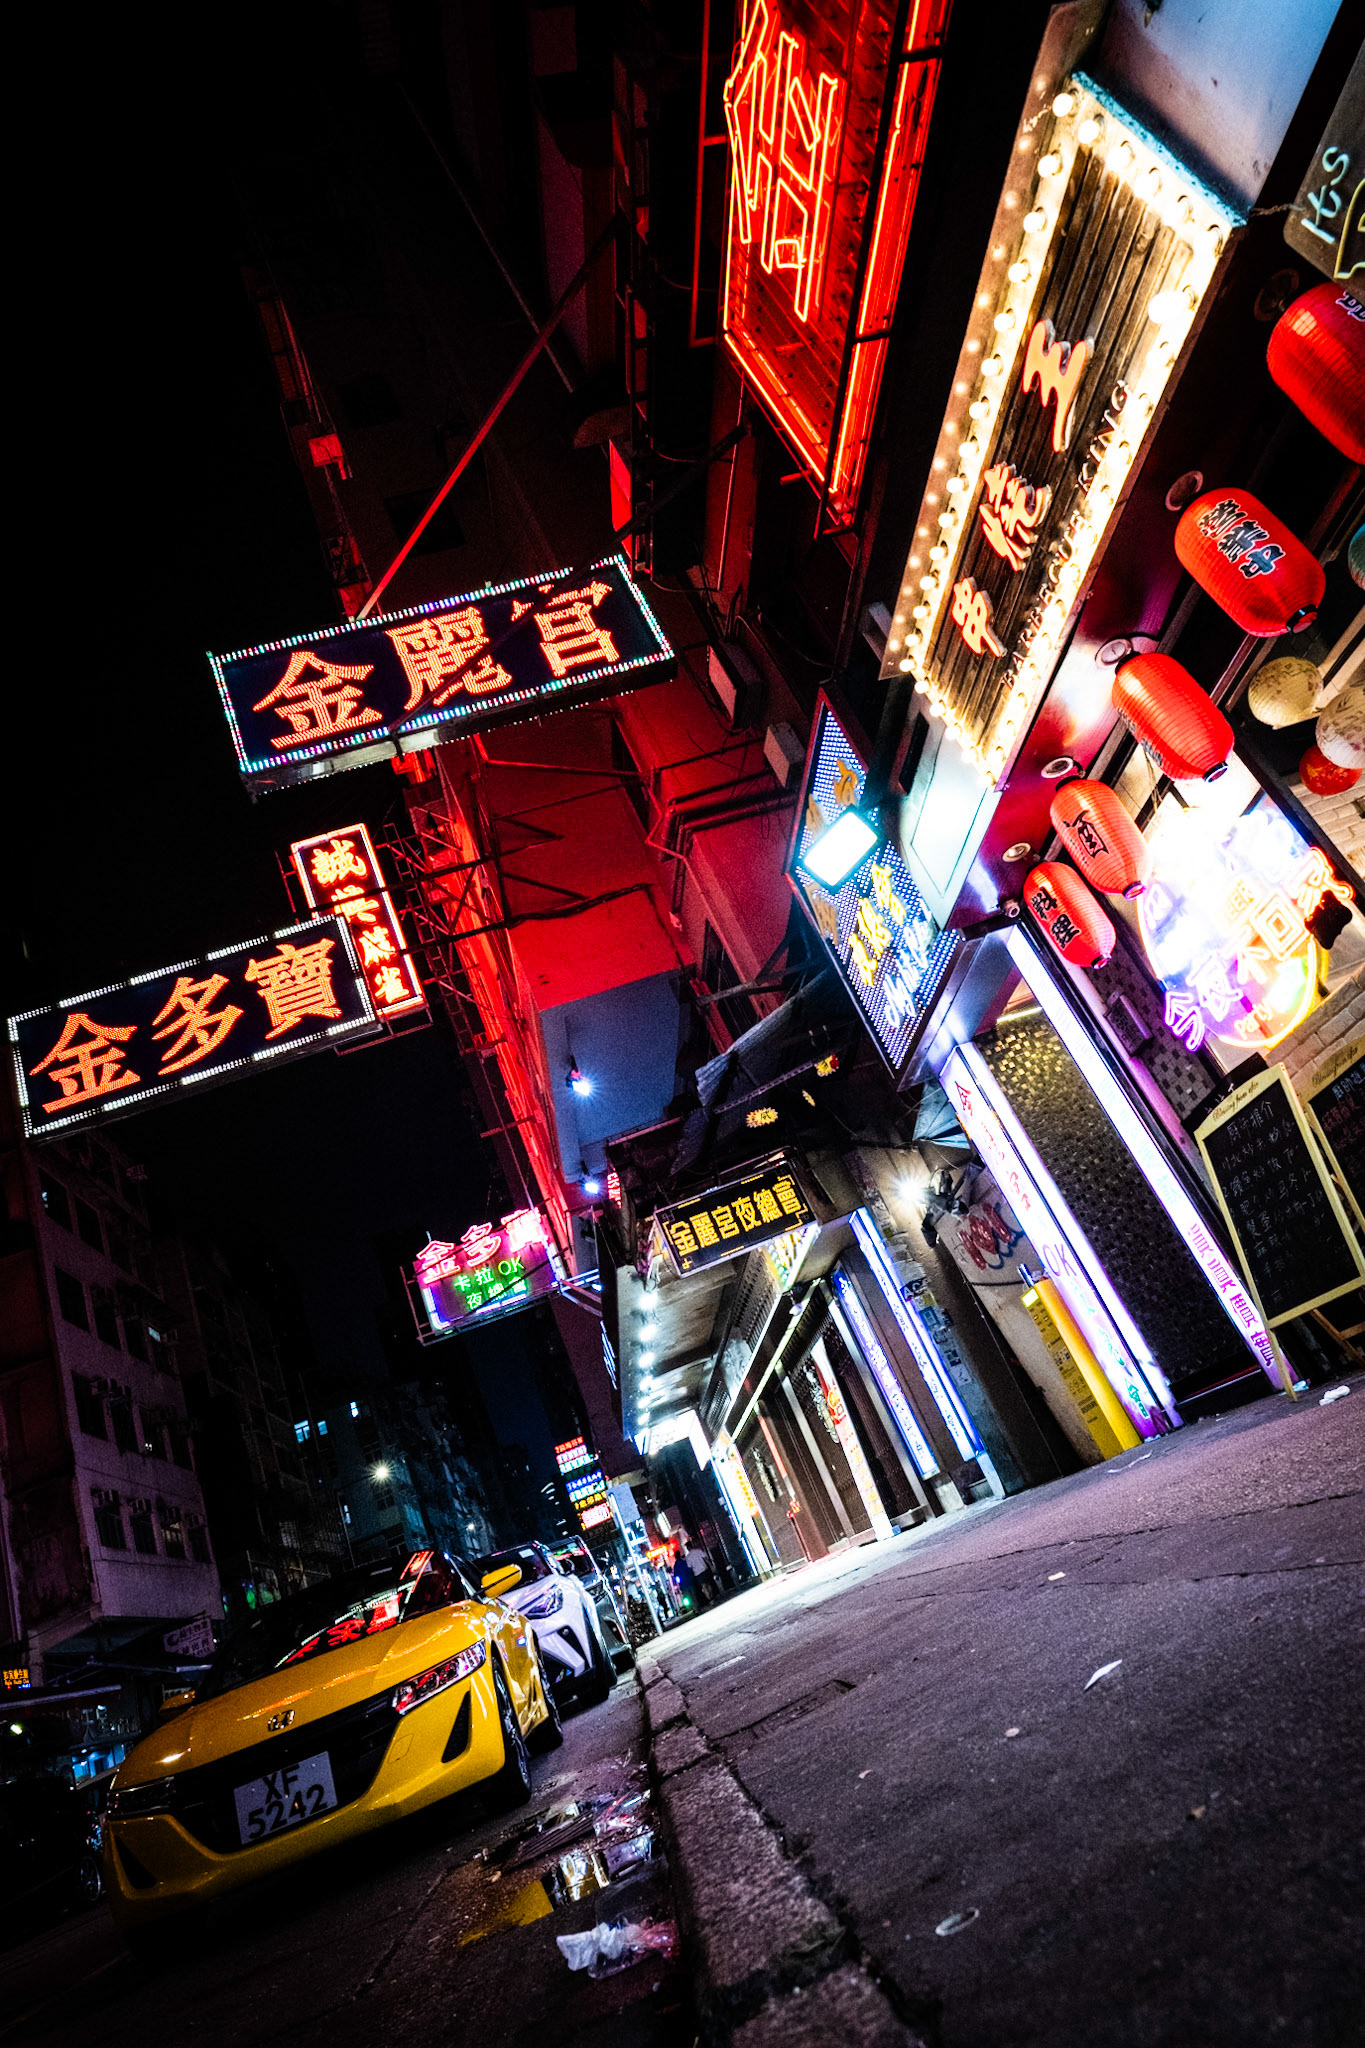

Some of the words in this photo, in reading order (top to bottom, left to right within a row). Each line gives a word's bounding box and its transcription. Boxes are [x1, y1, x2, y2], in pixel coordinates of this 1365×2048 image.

[1077, 379, 1131, 493] KING
[952, 318, 1095, 659] 串燒王
[253, 581, 620, 750] 金麗宮
[28, 937, 343, 1114] 金多寶
[416, 1209, 549, 1283] 金多寶
[669, 1176, 802, 1257] 金麗宮夜總會
[247, 1784, 329, 1838] 5242
[264, 1763, 299, 1803] XF
